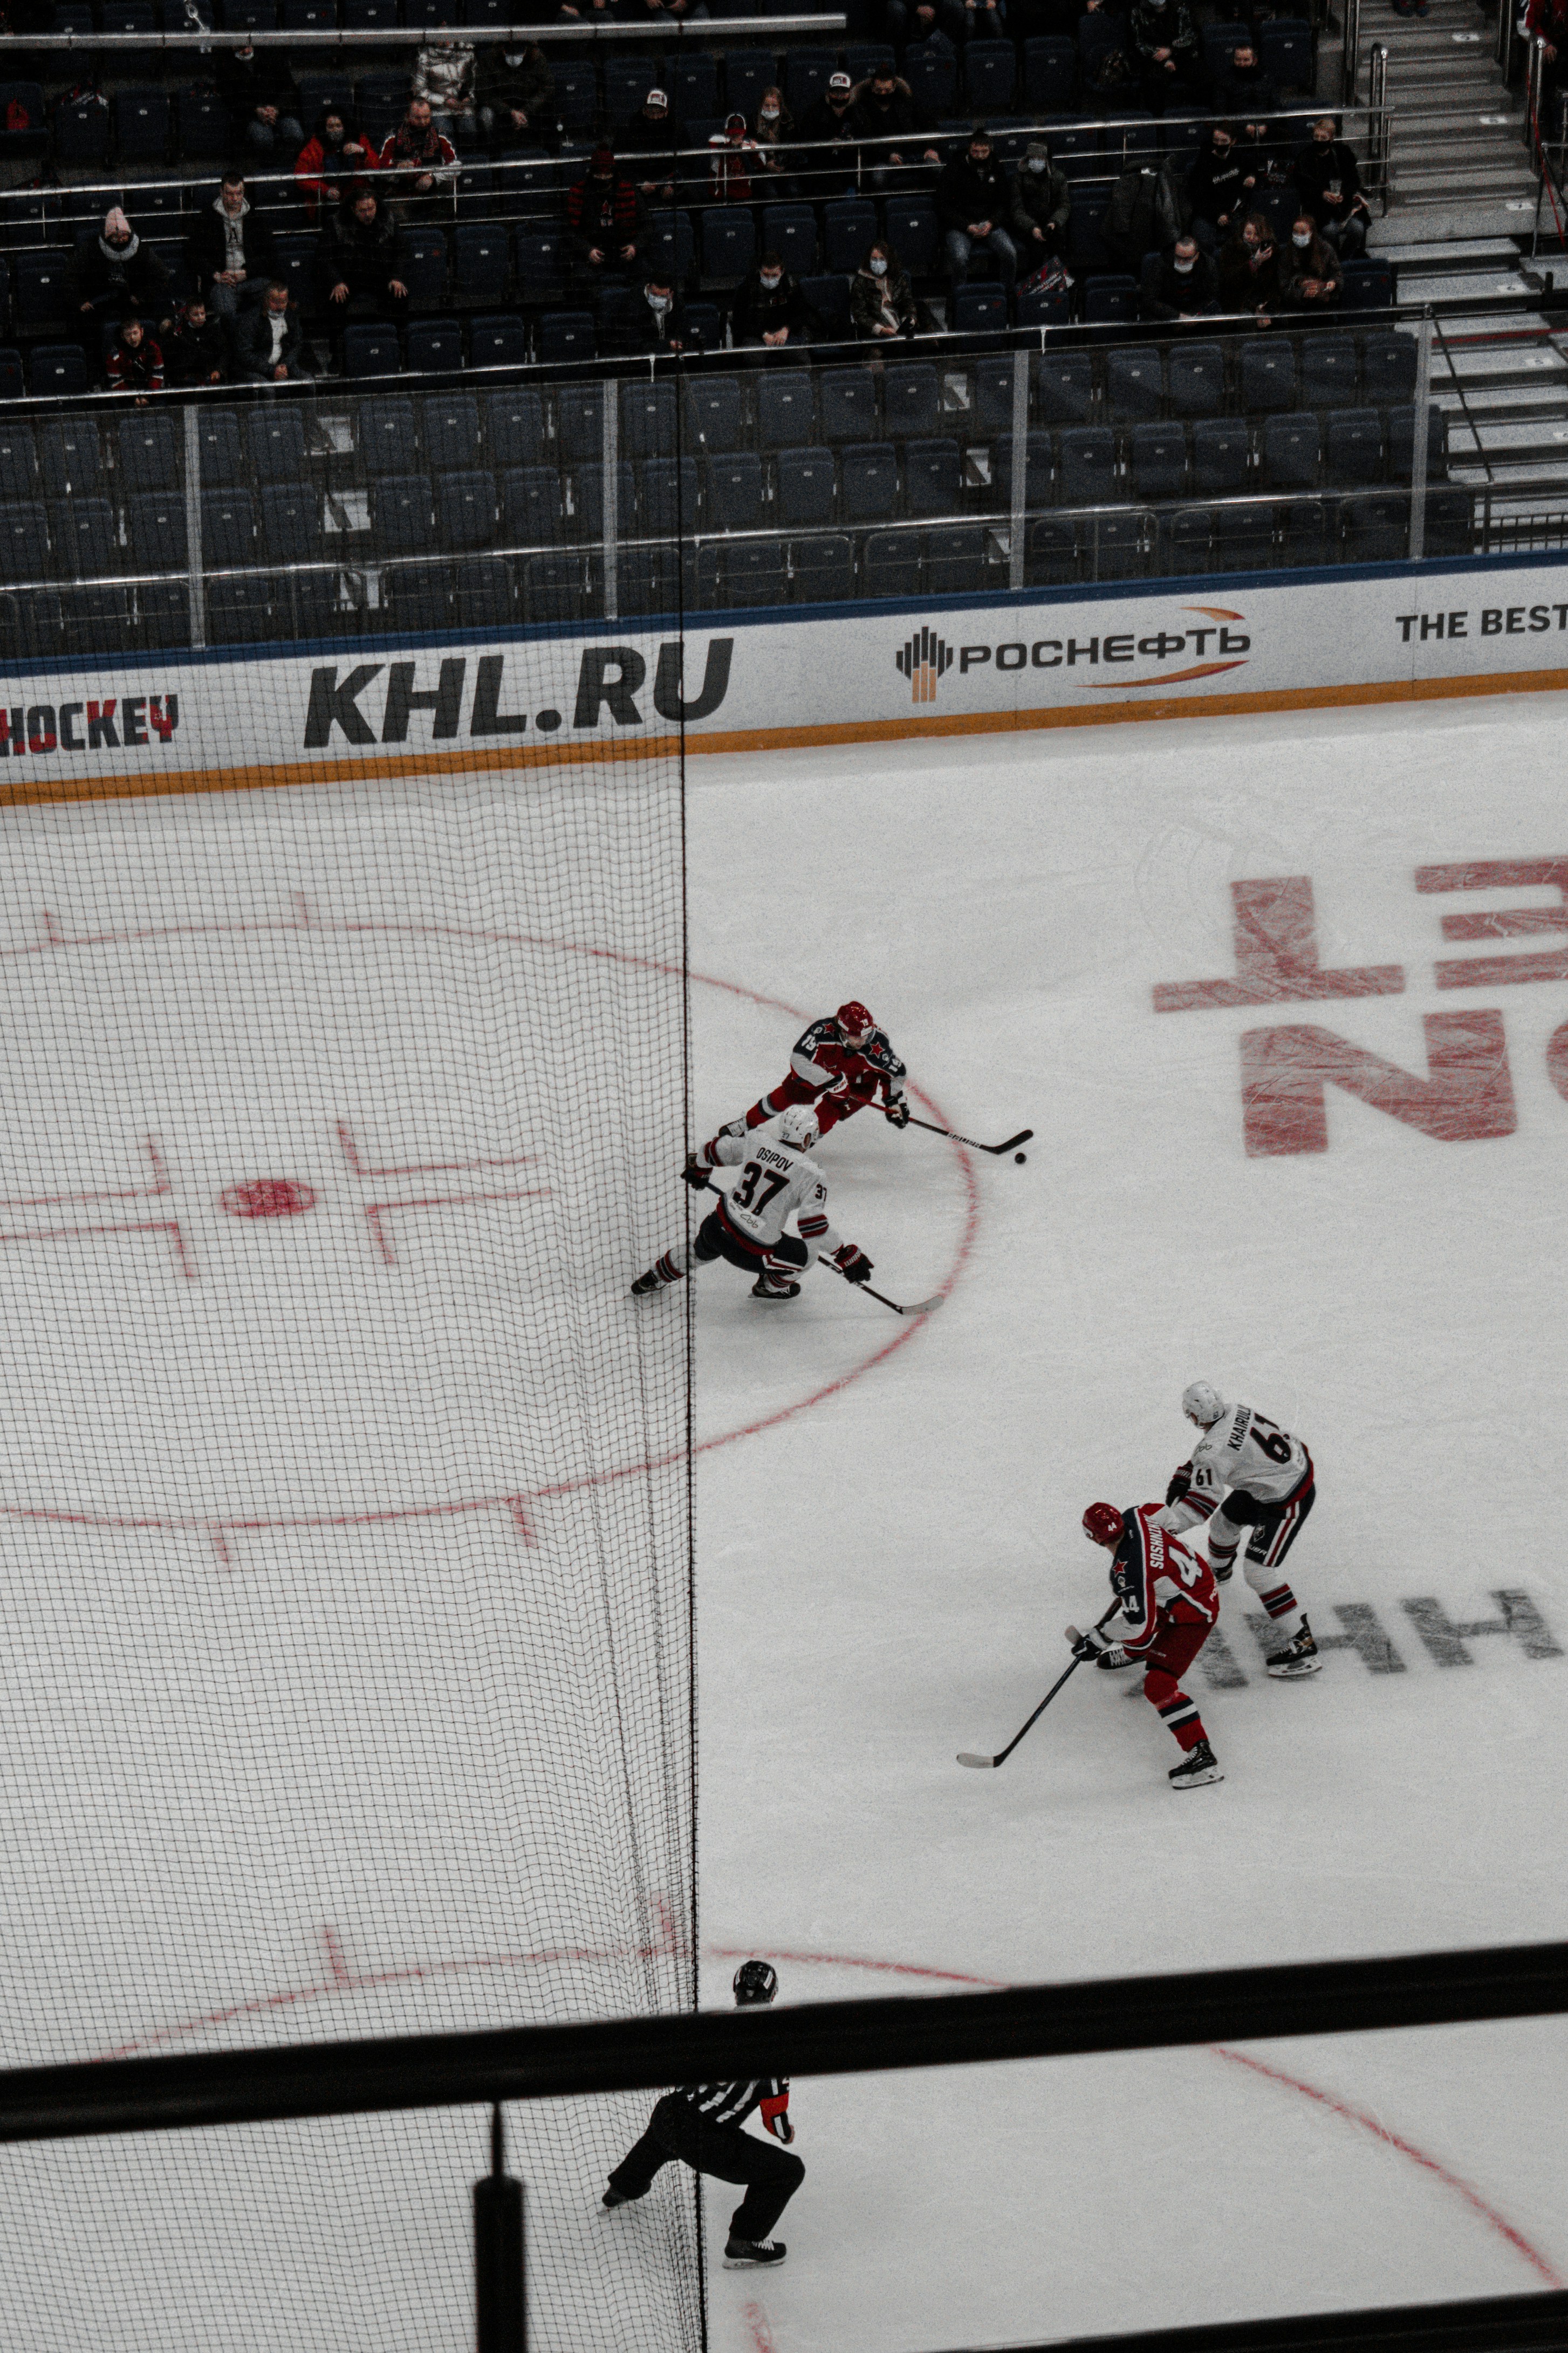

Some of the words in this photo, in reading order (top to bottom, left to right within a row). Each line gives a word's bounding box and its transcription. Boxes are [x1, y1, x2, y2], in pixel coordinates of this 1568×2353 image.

[1395, 611, 1468, 642] THE
[1481, 604, 1568, 636] BEST
[960, 627, 1251, 674] РОСНЕФТЬ
[304, 638, 734, 749] KHL.RU
[0, 694, 179, 757] HOCKEY
[756, 1147, 793, 1171] OSIPOV
[732, 1161, 791, 1216] 37
[1196, 1468, 1213, 1486] 61
[1107, 1521, 1118, 1532] 44
